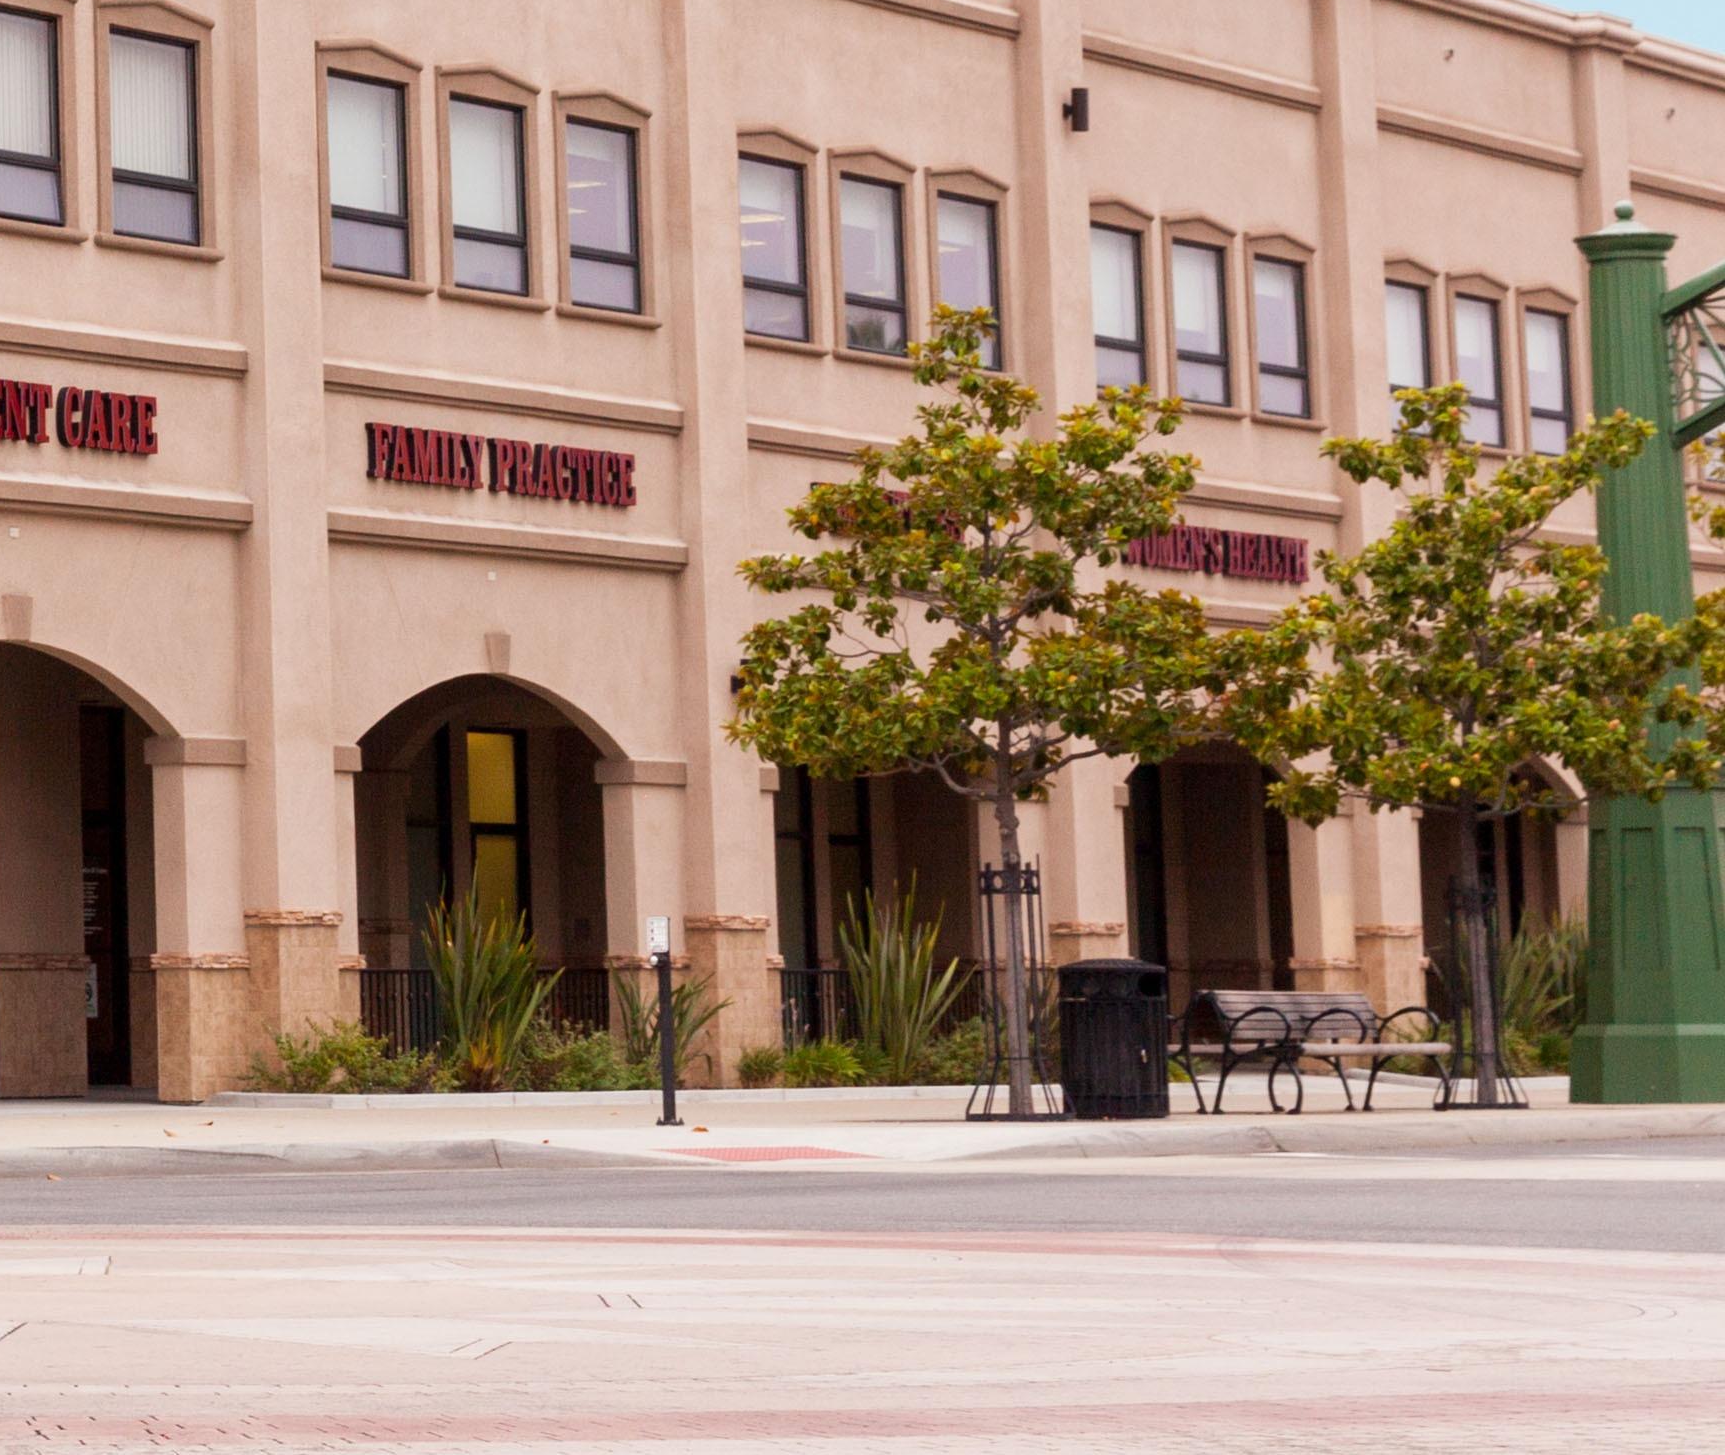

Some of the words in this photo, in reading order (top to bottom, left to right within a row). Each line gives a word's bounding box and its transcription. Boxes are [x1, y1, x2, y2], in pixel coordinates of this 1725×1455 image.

[56, 386, 158, 455] CARE
[365, 422, 485, 489] FAMILY
[486, 438, 637, 506] PRACTICE
[1223, 530, 1309, 582] HEALTH
